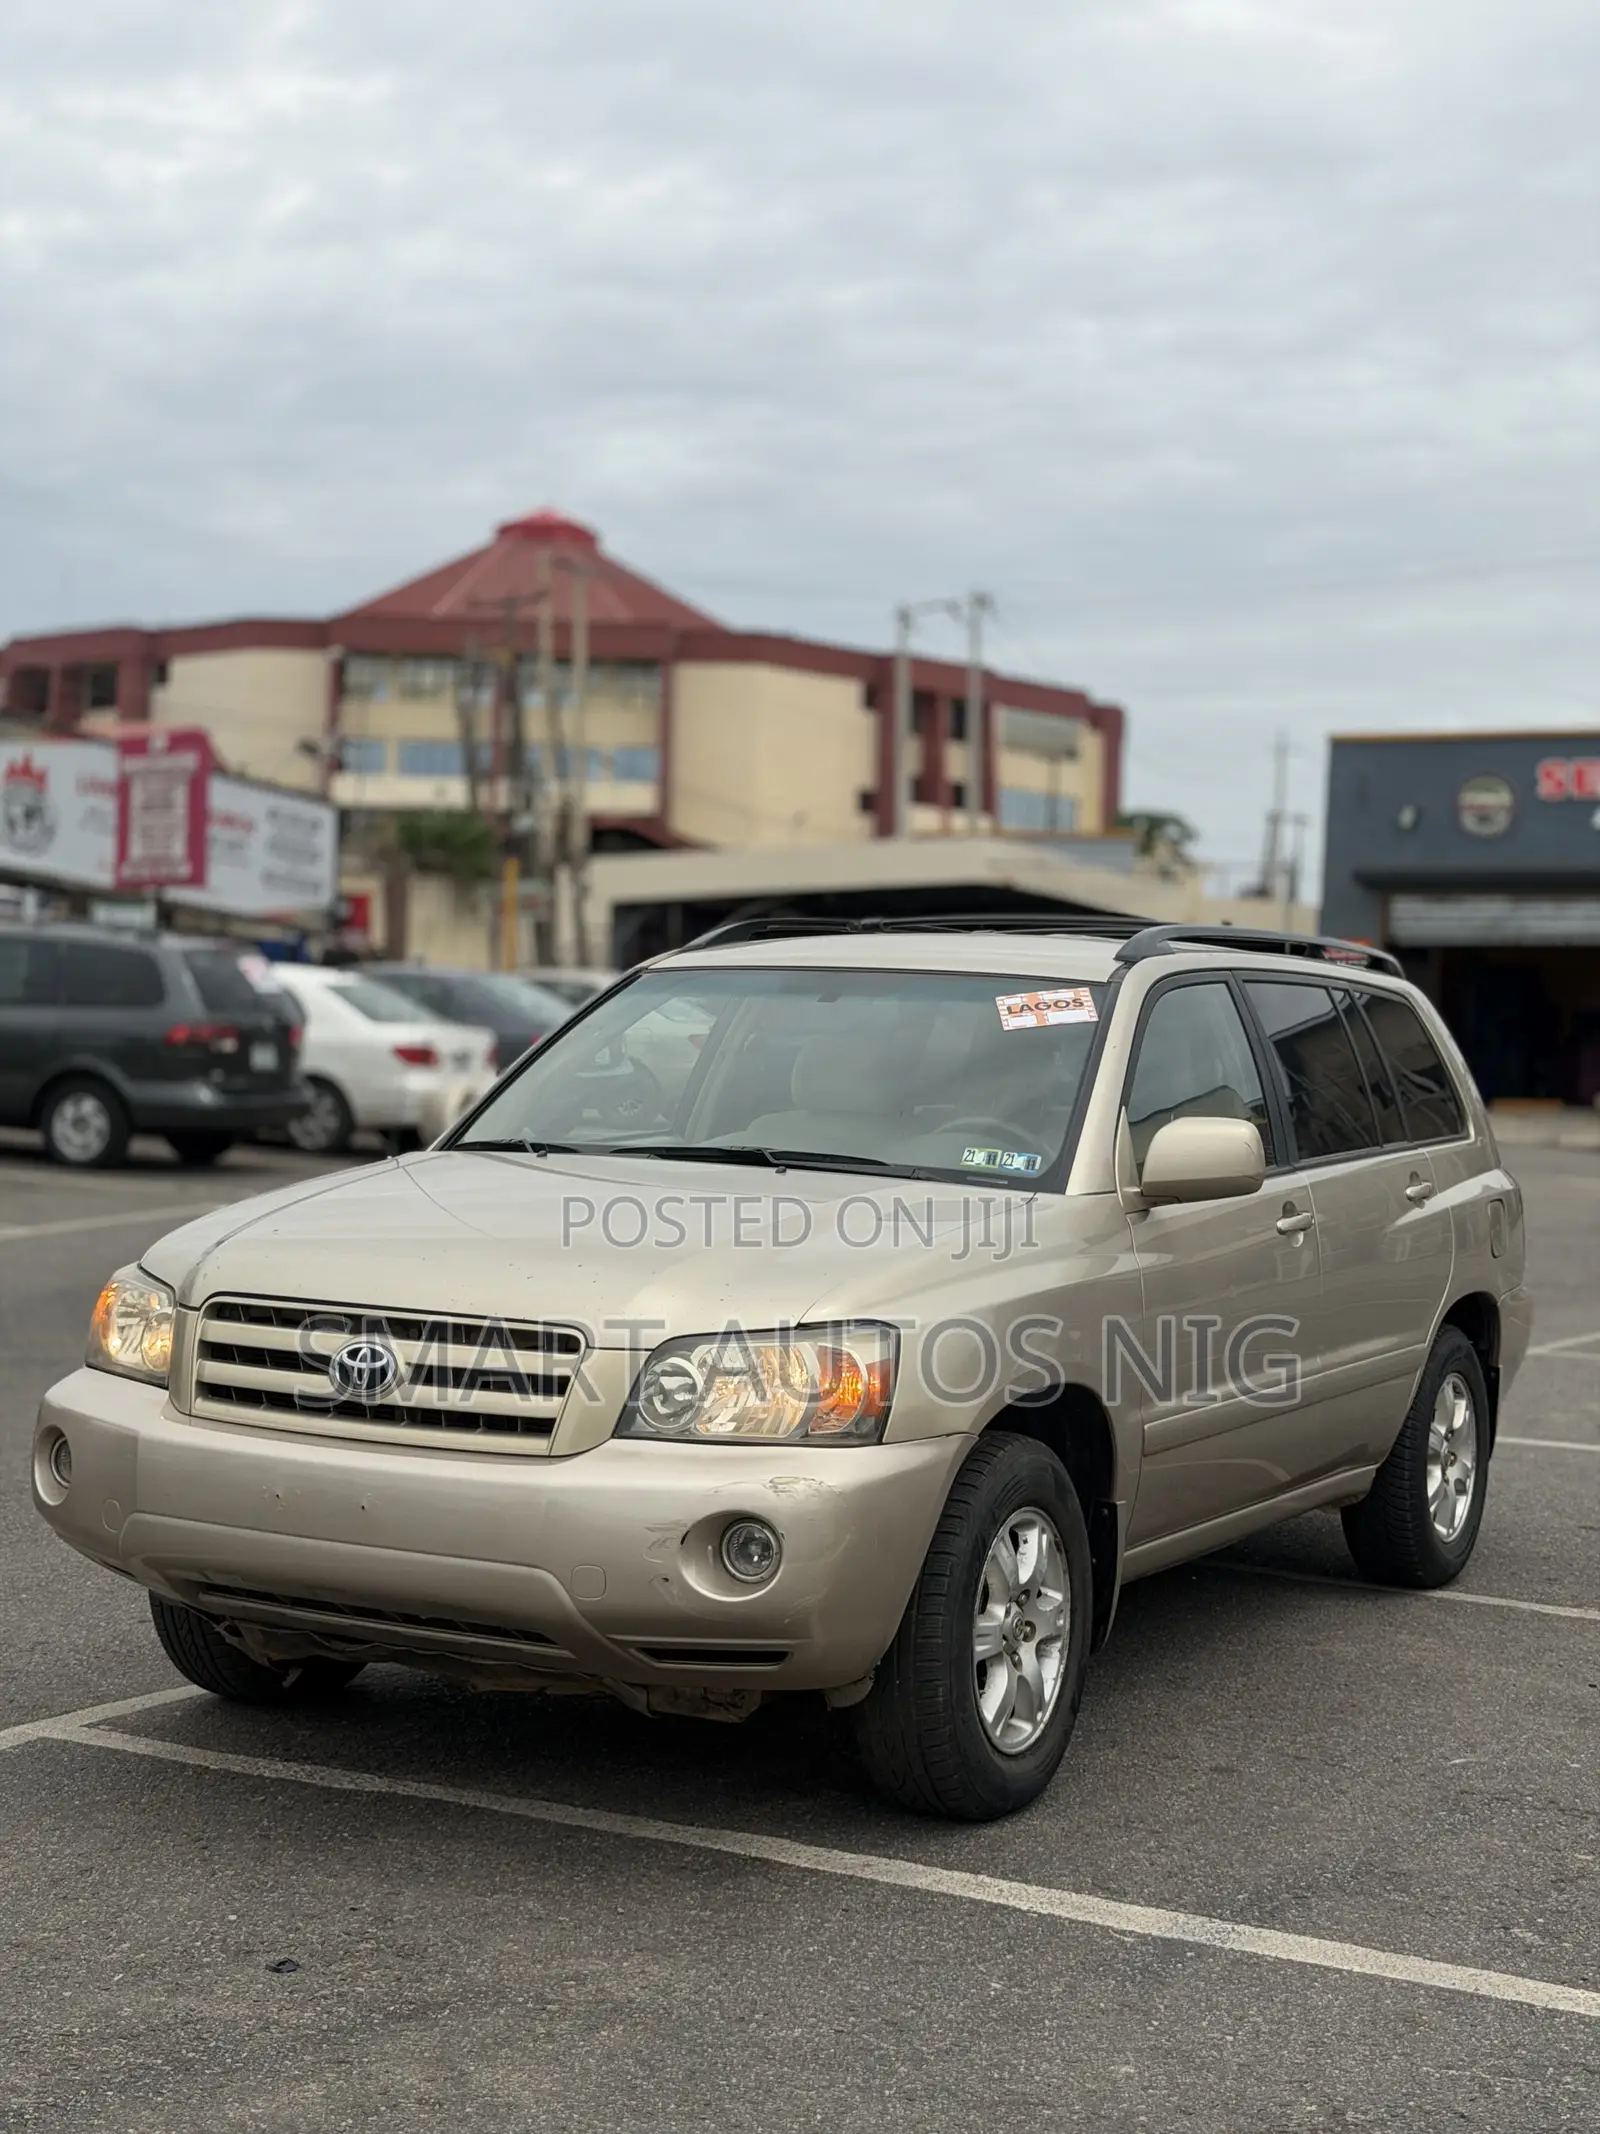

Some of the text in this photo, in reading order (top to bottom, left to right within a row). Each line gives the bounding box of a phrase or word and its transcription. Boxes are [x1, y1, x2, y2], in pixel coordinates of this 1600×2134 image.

[1006, 998, 1084, 1014] LAGOS
[964, 1149, 977, 1162] 21
[1004, 1153, 1016, 1166] 21
